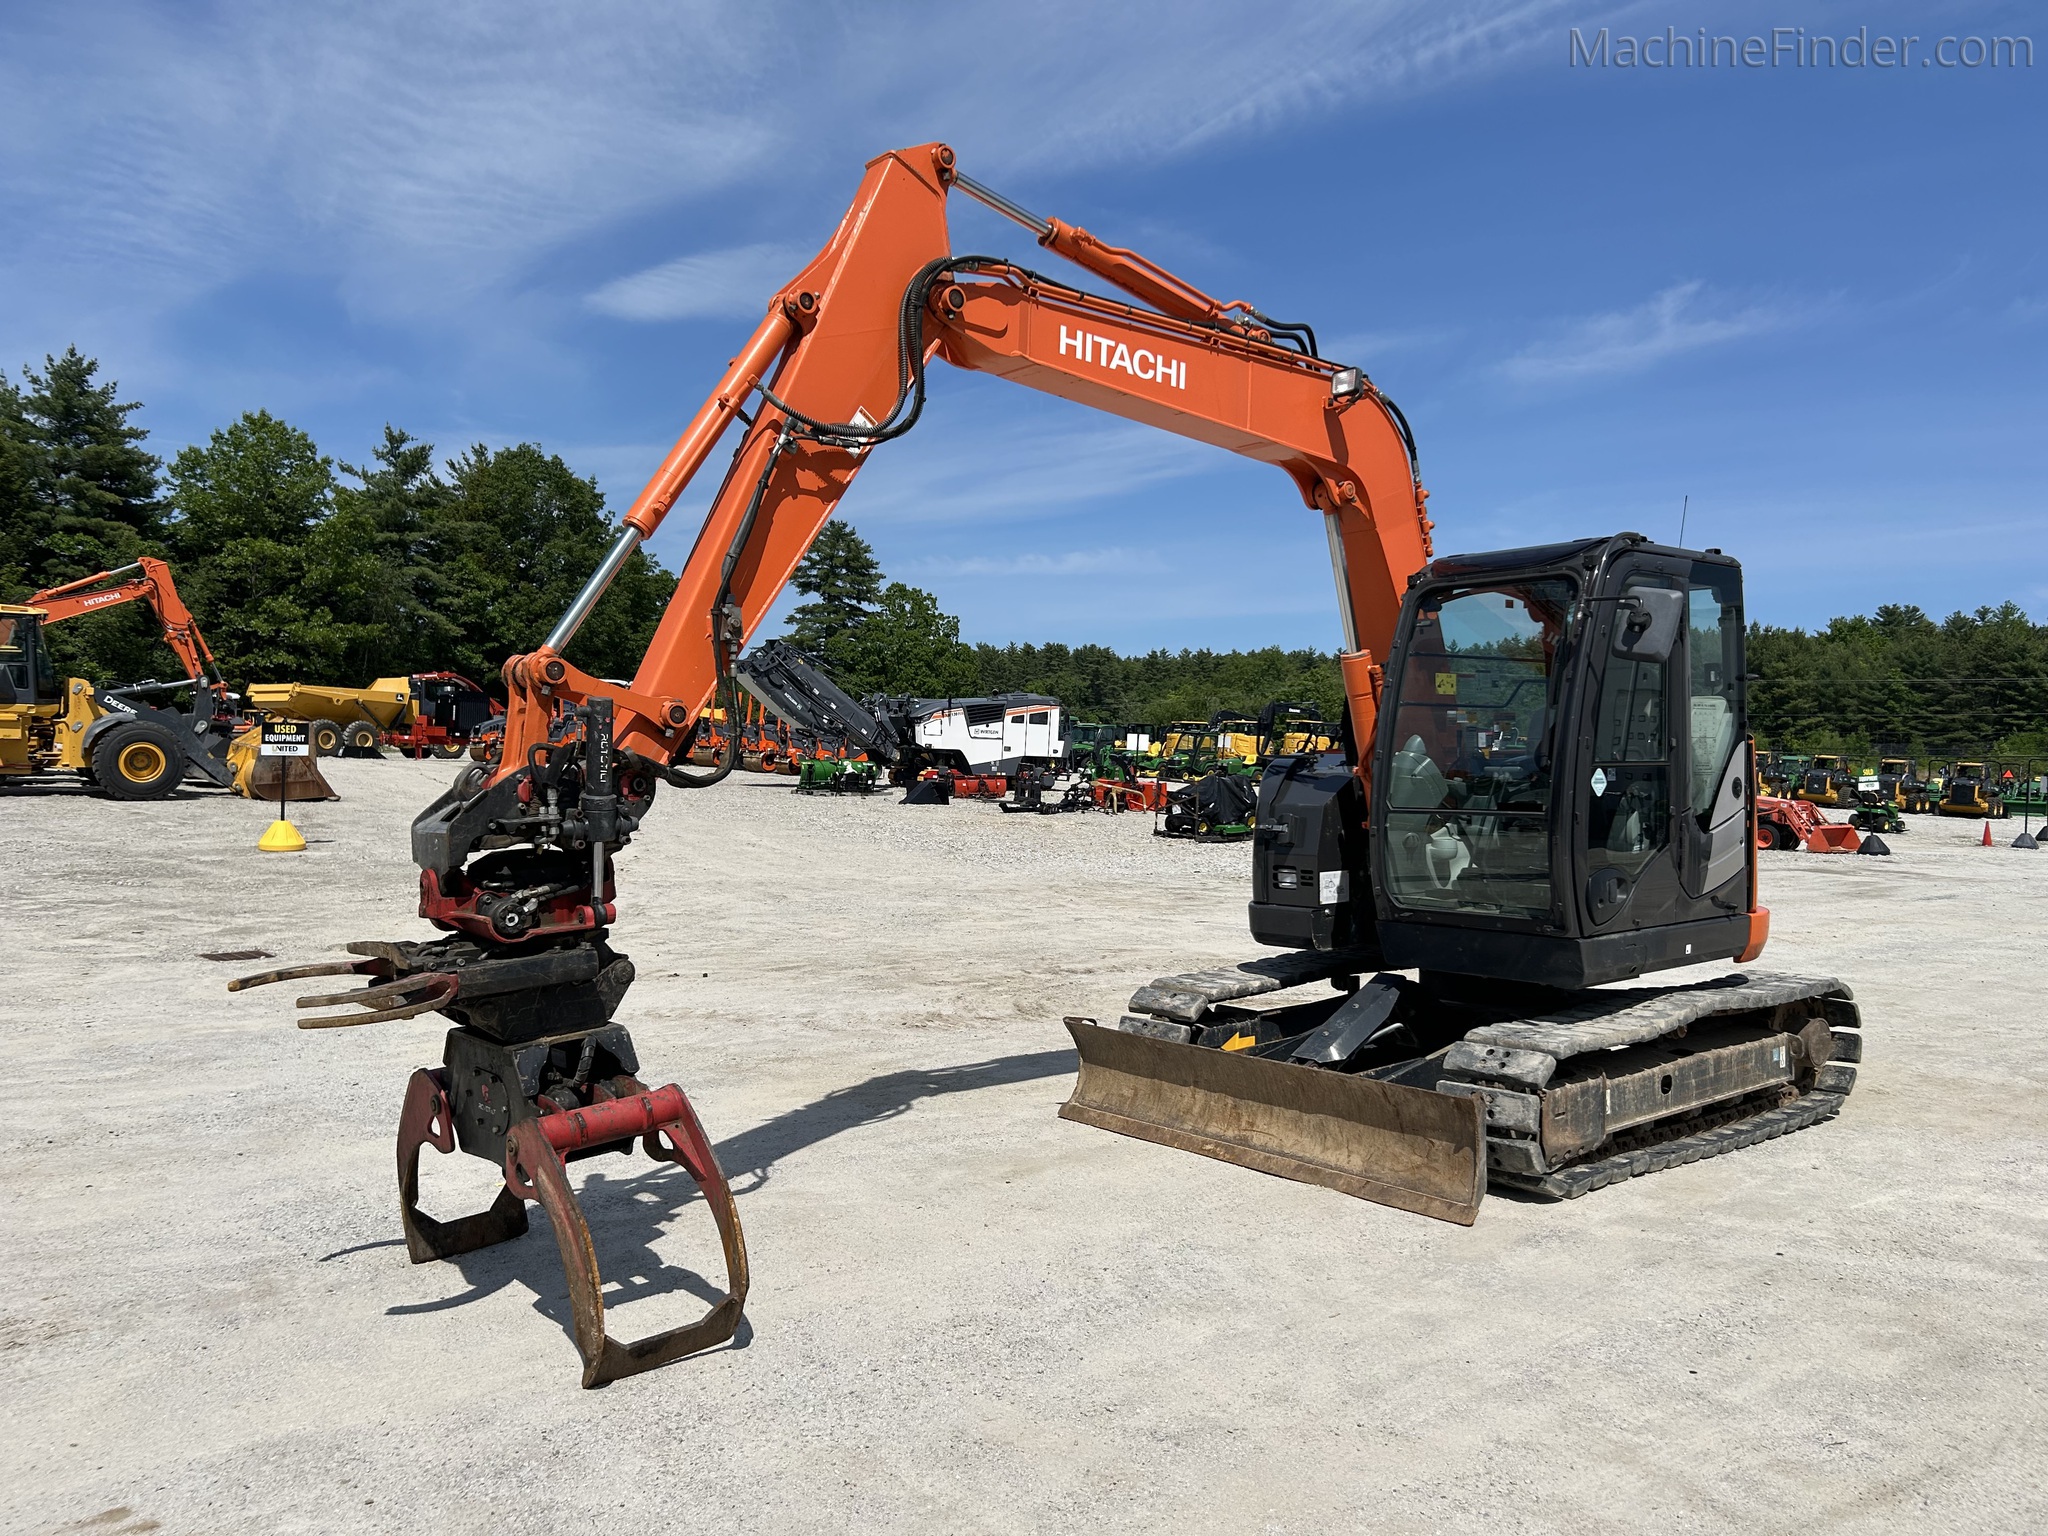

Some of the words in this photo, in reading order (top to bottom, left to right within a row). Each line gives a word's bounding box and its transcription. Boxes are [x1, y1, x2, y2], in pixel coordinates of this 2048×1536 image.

[1059, 324, 1186, 390] HITACHI
[83, 592, 121, 606] HITACHI
[274, 724, 297, 734] USED
[264, 733, 306, 743] EQUIPMENT
